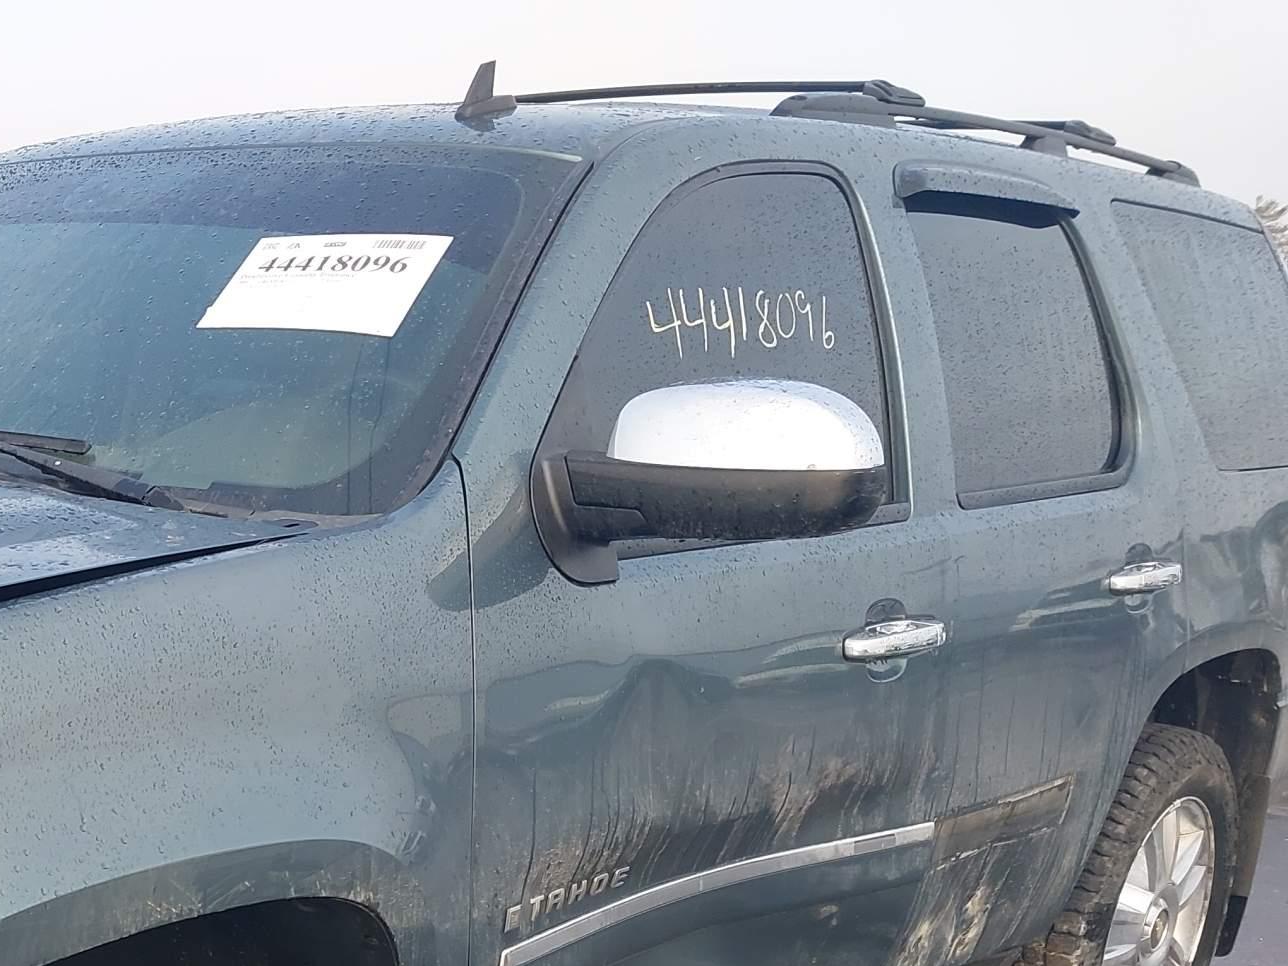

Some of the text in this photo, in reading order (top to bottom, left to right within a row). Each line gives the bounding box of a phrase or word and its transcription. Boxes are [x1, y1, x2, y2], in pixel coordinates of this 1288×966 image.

[257, 254, 412, 274] 44418096
[646, 286, 835, 360] 44418096
[529, 866, 631, 922] TAHOE
